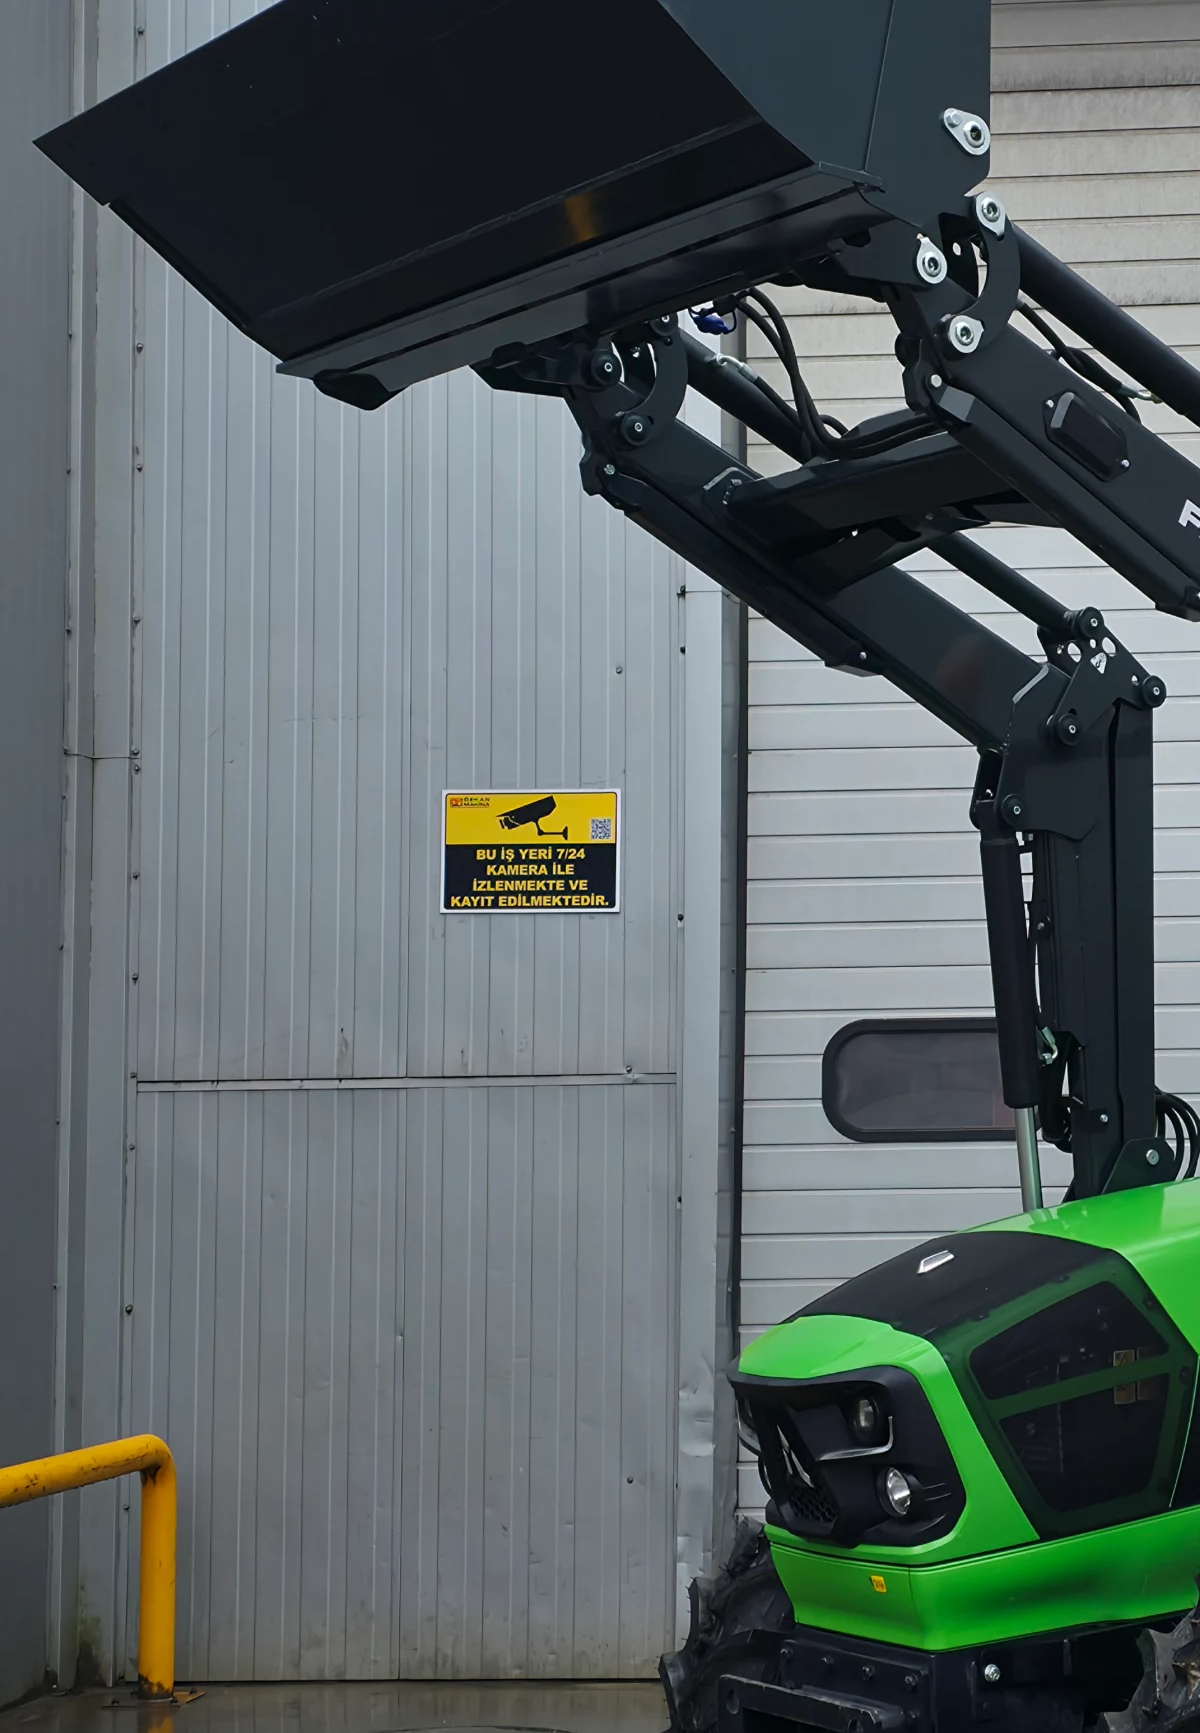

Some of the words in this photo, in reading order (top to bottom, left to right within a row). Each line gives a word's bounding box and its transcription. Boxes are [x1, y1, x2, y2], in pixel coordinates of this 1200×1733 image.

[476, 849, 496, 860] BU
[501, 847, 515, 862] İŞ
[519, 847, 552, 860] YERİ
[556, 848, 586, 860] 7/24
[486, 865, 548, 876] KAMERA
[552, 863, 574, 875] İLE
[472, 878, 565, 892] İZLENMEKTE
[569, 880, 588, 891] VE
[450, 896, 495, 907] KAYIT
[498, 893, 609, 907] EDİLMEKTEDİR.
